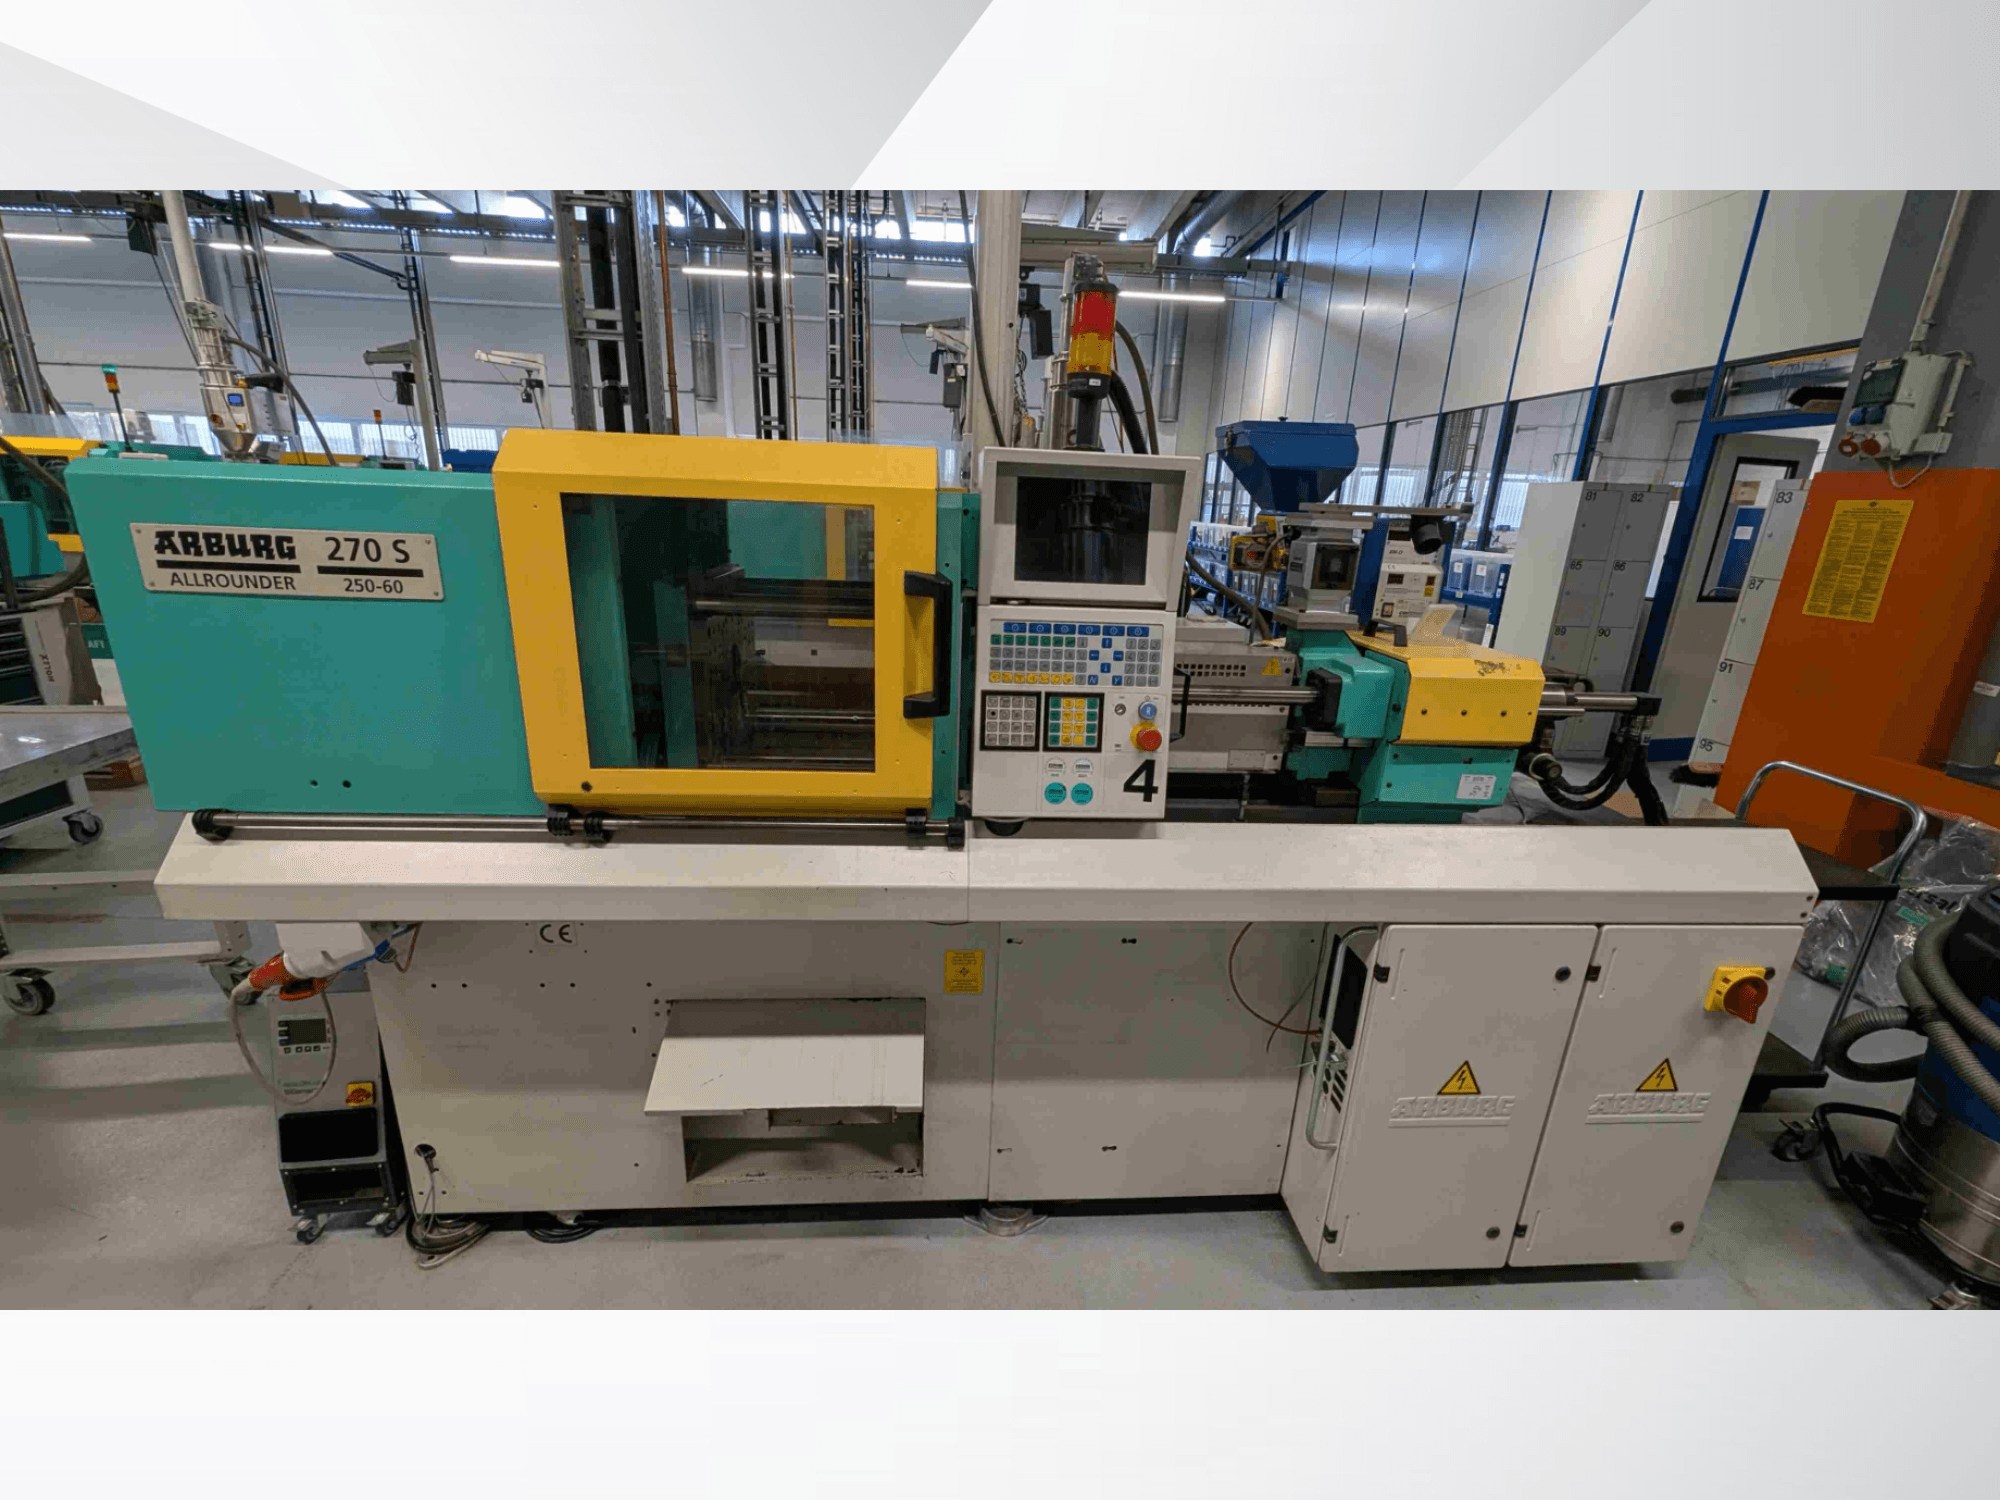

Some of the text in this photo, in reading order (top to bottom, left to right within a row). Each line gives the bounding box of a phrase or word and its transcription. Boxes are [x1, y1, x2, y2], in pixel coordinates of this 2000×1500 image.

[1585, 491, 1597, 501] 81
[1630, 493, 1644, 503] 82
[1776, 491, 1793, 503] 83
[154, 530, 297, 560] ARBURG
[324, 536, 410, 564] 270 S
[1613, 562, 1626, 571] 86
[170, 572, 297, 591] ALLROUNDER
[343, 578, 404, 595] 250-60
[1749, 579, 1764, 591] 87
[1554, 626, 1566, 636] 89
[1597, 628, 1611, 637] 90
[1719, 661, 1733, 673] 91
[1700, 738, 1714, 752] 95
[1123, 759, 1159, 802] 4
[540, 923, 573, 943] CE
